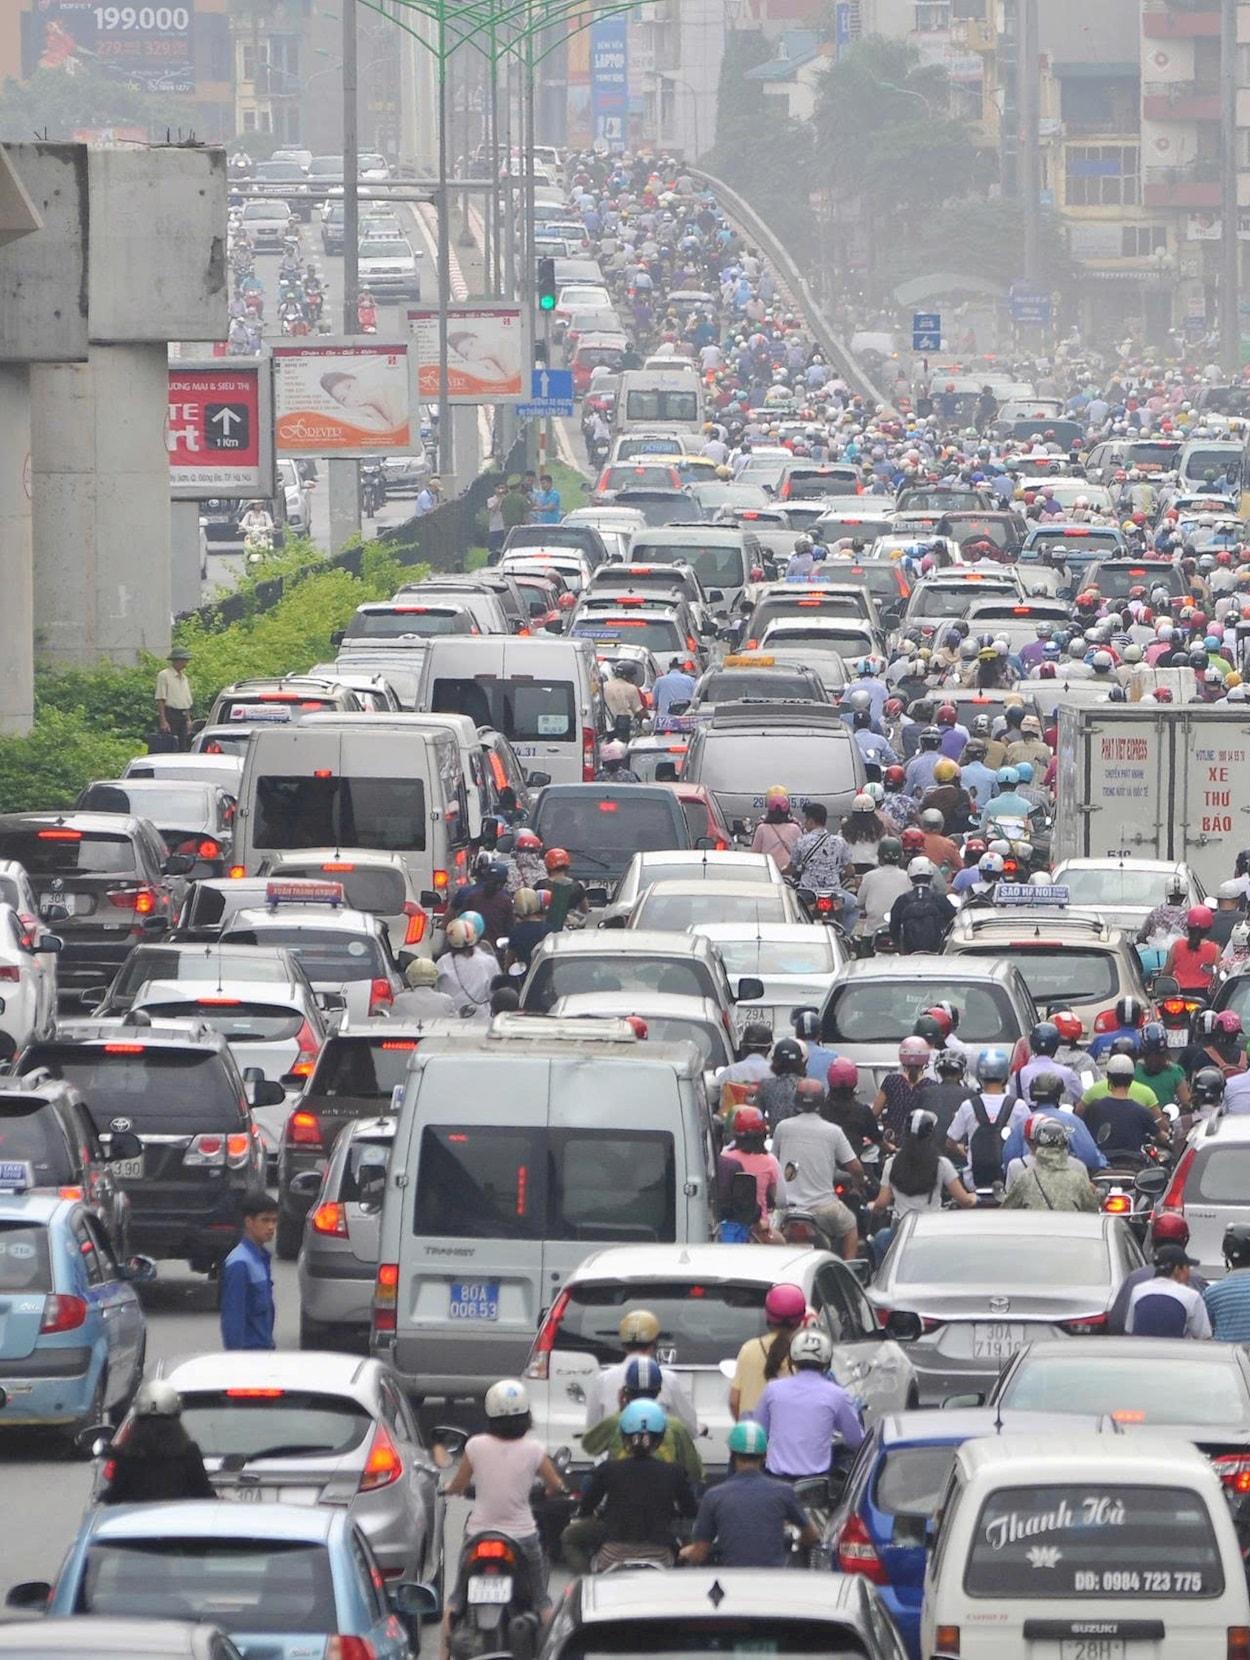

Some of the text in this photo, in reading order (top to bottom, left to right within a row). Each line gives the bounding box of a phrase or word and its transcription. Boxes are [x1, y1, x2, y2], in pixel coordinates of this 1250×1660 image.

[93, 6, 190, 30] 199.000
[1209, 767, 1229, 782] XE
[1203, 789, 1231, 807] THƯ
[1202, 812, 1232, 832] BÁO
[1001, 886, 1020, 897] SAO
[460, 1284, 488, 1301] 80A
[986, 1325, 1012, 1340] 30A
[985, 1496, 1127, 1551] Thanh Hà
[1102, 1571, 1140, 1591] 0984
[1143, 1571, 1171, 1592] 723
[1173, 1571, 1202, 1592] 775
[1070, 1623, 1118, 1634] SUZUKI
